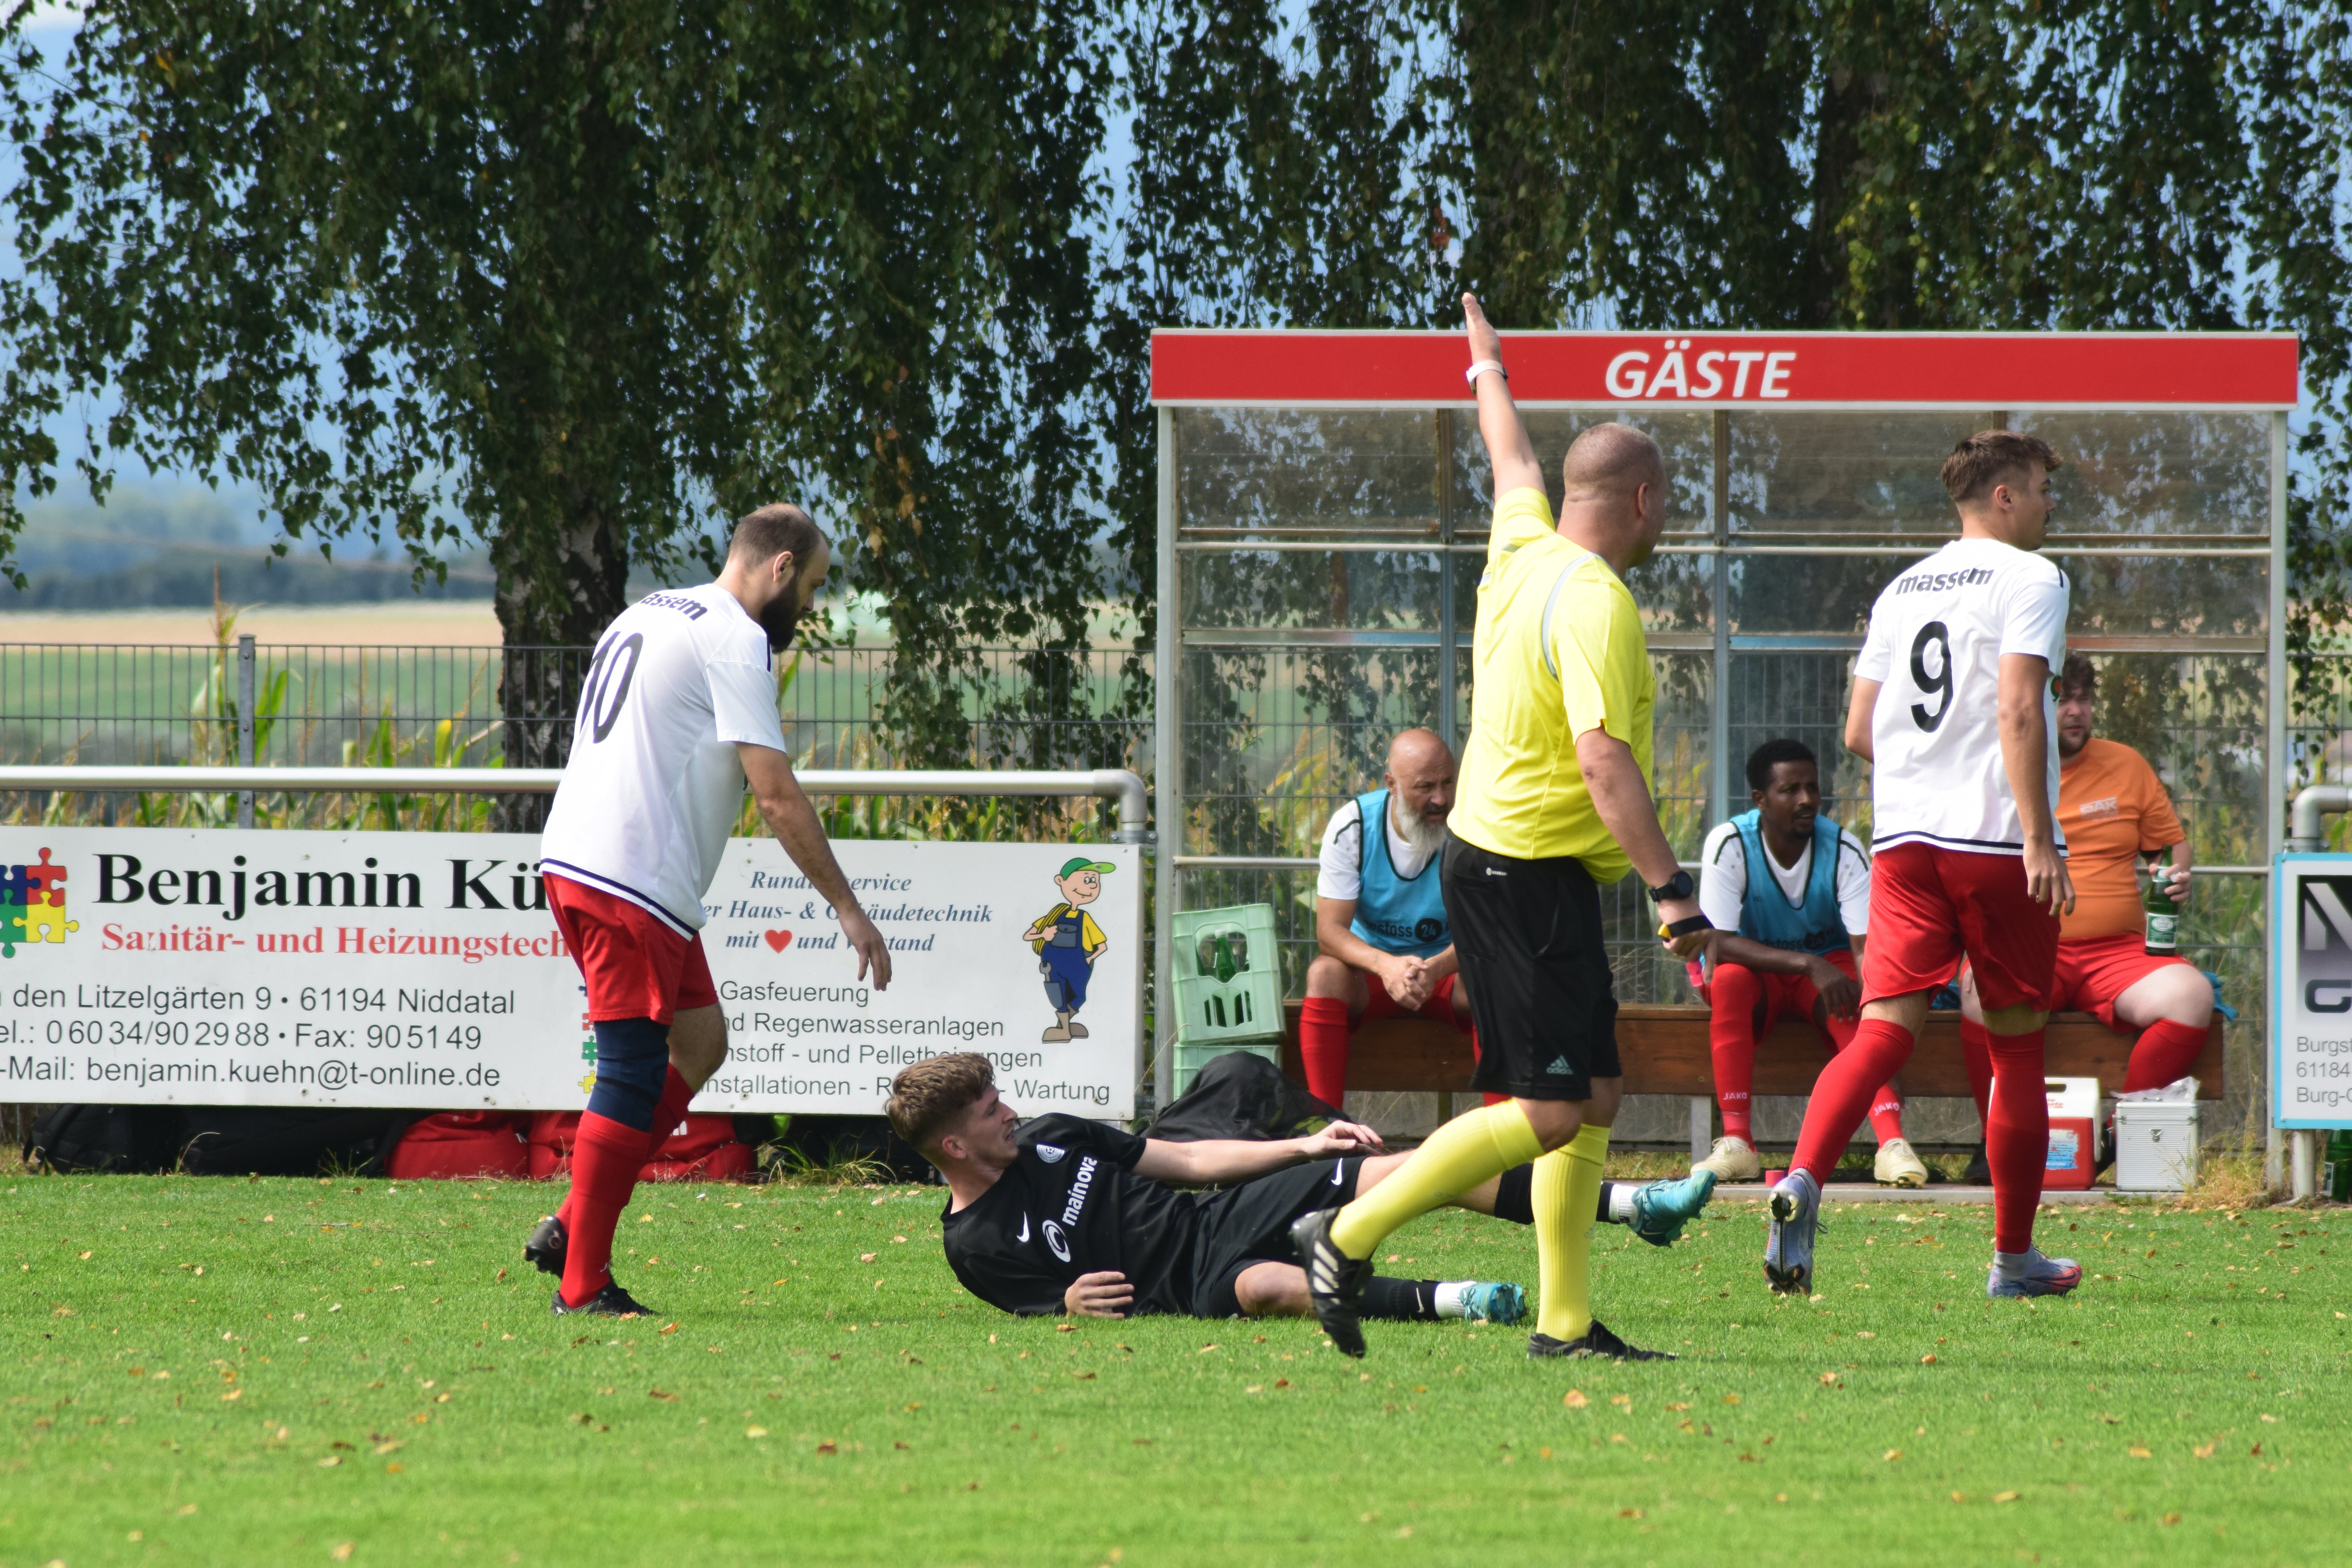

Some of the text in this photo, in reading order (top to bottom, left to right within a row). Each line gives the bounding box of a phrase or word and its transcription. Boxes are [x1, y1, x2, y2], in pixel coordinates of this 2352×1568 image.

[1605, 339, 1796, 398] GÄSTE
[1895, 568, 1994, 595] massem
[579, 631, 644, 744] 10
[1910, 621, 1954, 733] 9
[92, 853, 424, 921] Benjamin
[727, 900, 792, 919] Haus-
[799, 902, 816, 919] &
[102, 923, 572, 964] Sanitär- und Heizungstech
[726, 930, 759, 949] mit
[797, 932, 838, 950] und
[1421, 925, 1436, 937] 24
[13, 983, 66, 1008] den
[78, 984, 244, 1015] Litzelgärten
[255, 987, 271, 1010] 9
[299, 987, 387, 1012] 61194
[398, 988, 515, 1014] Niddatal
[720, 980, 869, 1007] Gasfeuerung
[295, 1023, 356, 1048] Fax:
[755, 1012, 1004, 1041] Regenwasseranlagen
[808, 1045, 850, 1063] und
[87, 1056, 500, 1091] benjamin.kuehn@t-online.de
[2296, 1061, 2350, 1078] 61184
[1014, 1079, 1110, 1105] Wartung
[1874, 1102, 1900, 1117] JAKO
[1062, 1156, 1098, 1227] mainova
